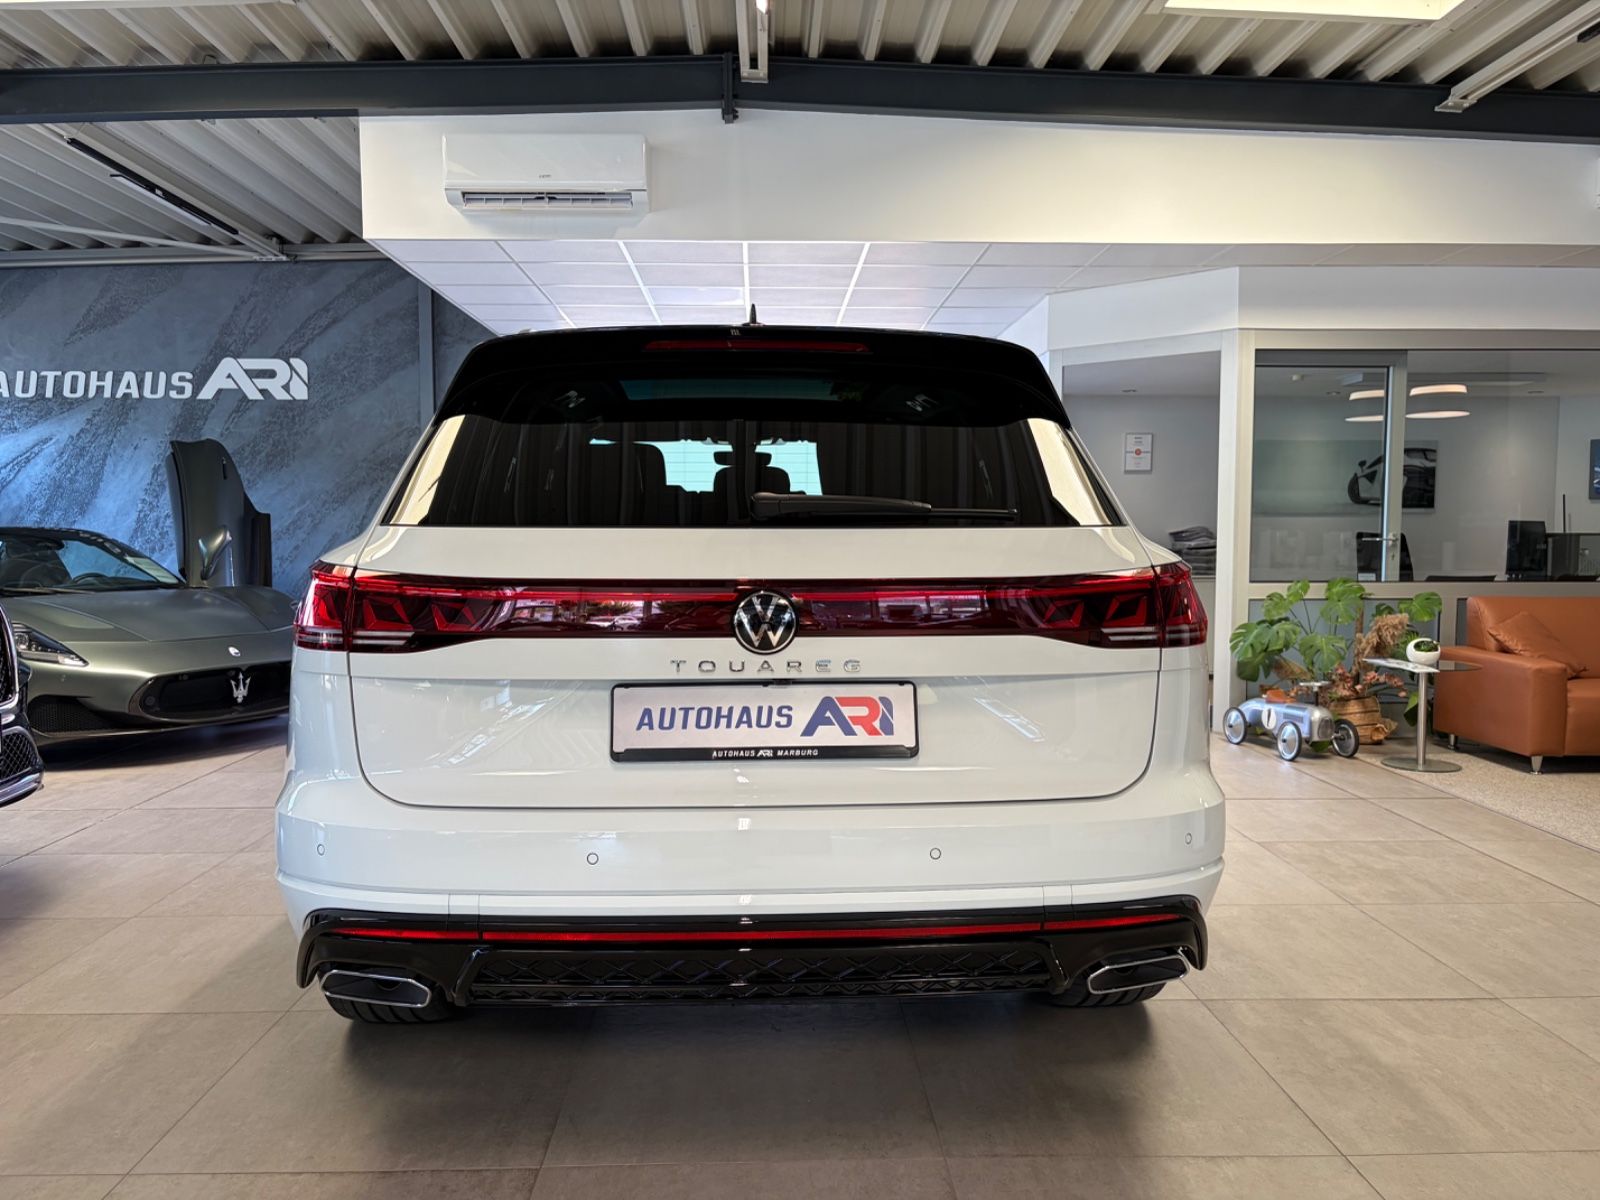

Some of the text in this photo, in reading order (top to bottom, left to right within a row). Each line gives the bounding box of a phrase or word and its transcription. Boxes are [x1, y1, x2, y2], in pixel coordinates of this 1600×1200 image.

[196, 357, 309, 400] ARI
[670, 659, 862, 674] TOUAREG
[636, 695, 894, 737] AUTOHAUS ARI
[712, 749, 755, 758] AUTOHAUS
[777, 748, 819, 757] MARBURG
